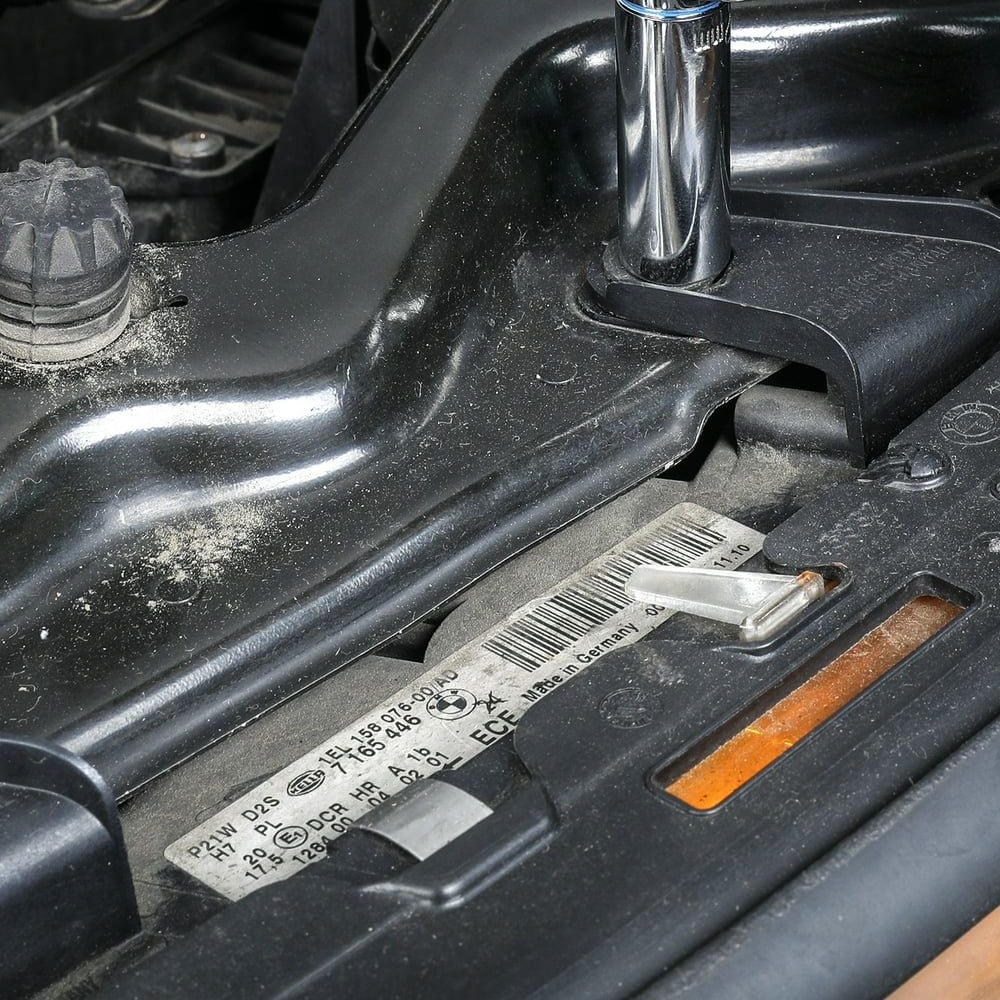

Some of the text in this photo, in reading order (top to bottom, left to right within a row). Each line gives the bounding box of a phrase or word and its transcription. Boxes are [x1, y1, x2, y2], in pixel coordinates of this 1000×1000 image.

[714, 545, 750, 568] 11.10
[521, 676, 563, 702] Made
[561, 664, 579, 675] in
[577, 622, 639, 665] Germany
[318, 745, 352, 764] 1EL
[350, 722, 381, 743] 158
[330, 714, 421, 774] 7 165 446
[470, 710, 518, 745] ECE
[287, 769, 326, 797] HELLA
[400, 770, 424, 785] 02
[426, 751, 448, 766] 01
[305, 747, 430, 831] DCR HR A 1b
[187, 796, 279, 858] P21W D2S
[209, 820, 282, 861] H7 PL
[242, 848, 266, 865] 20
[245, 853, 284, 879] 17,5
